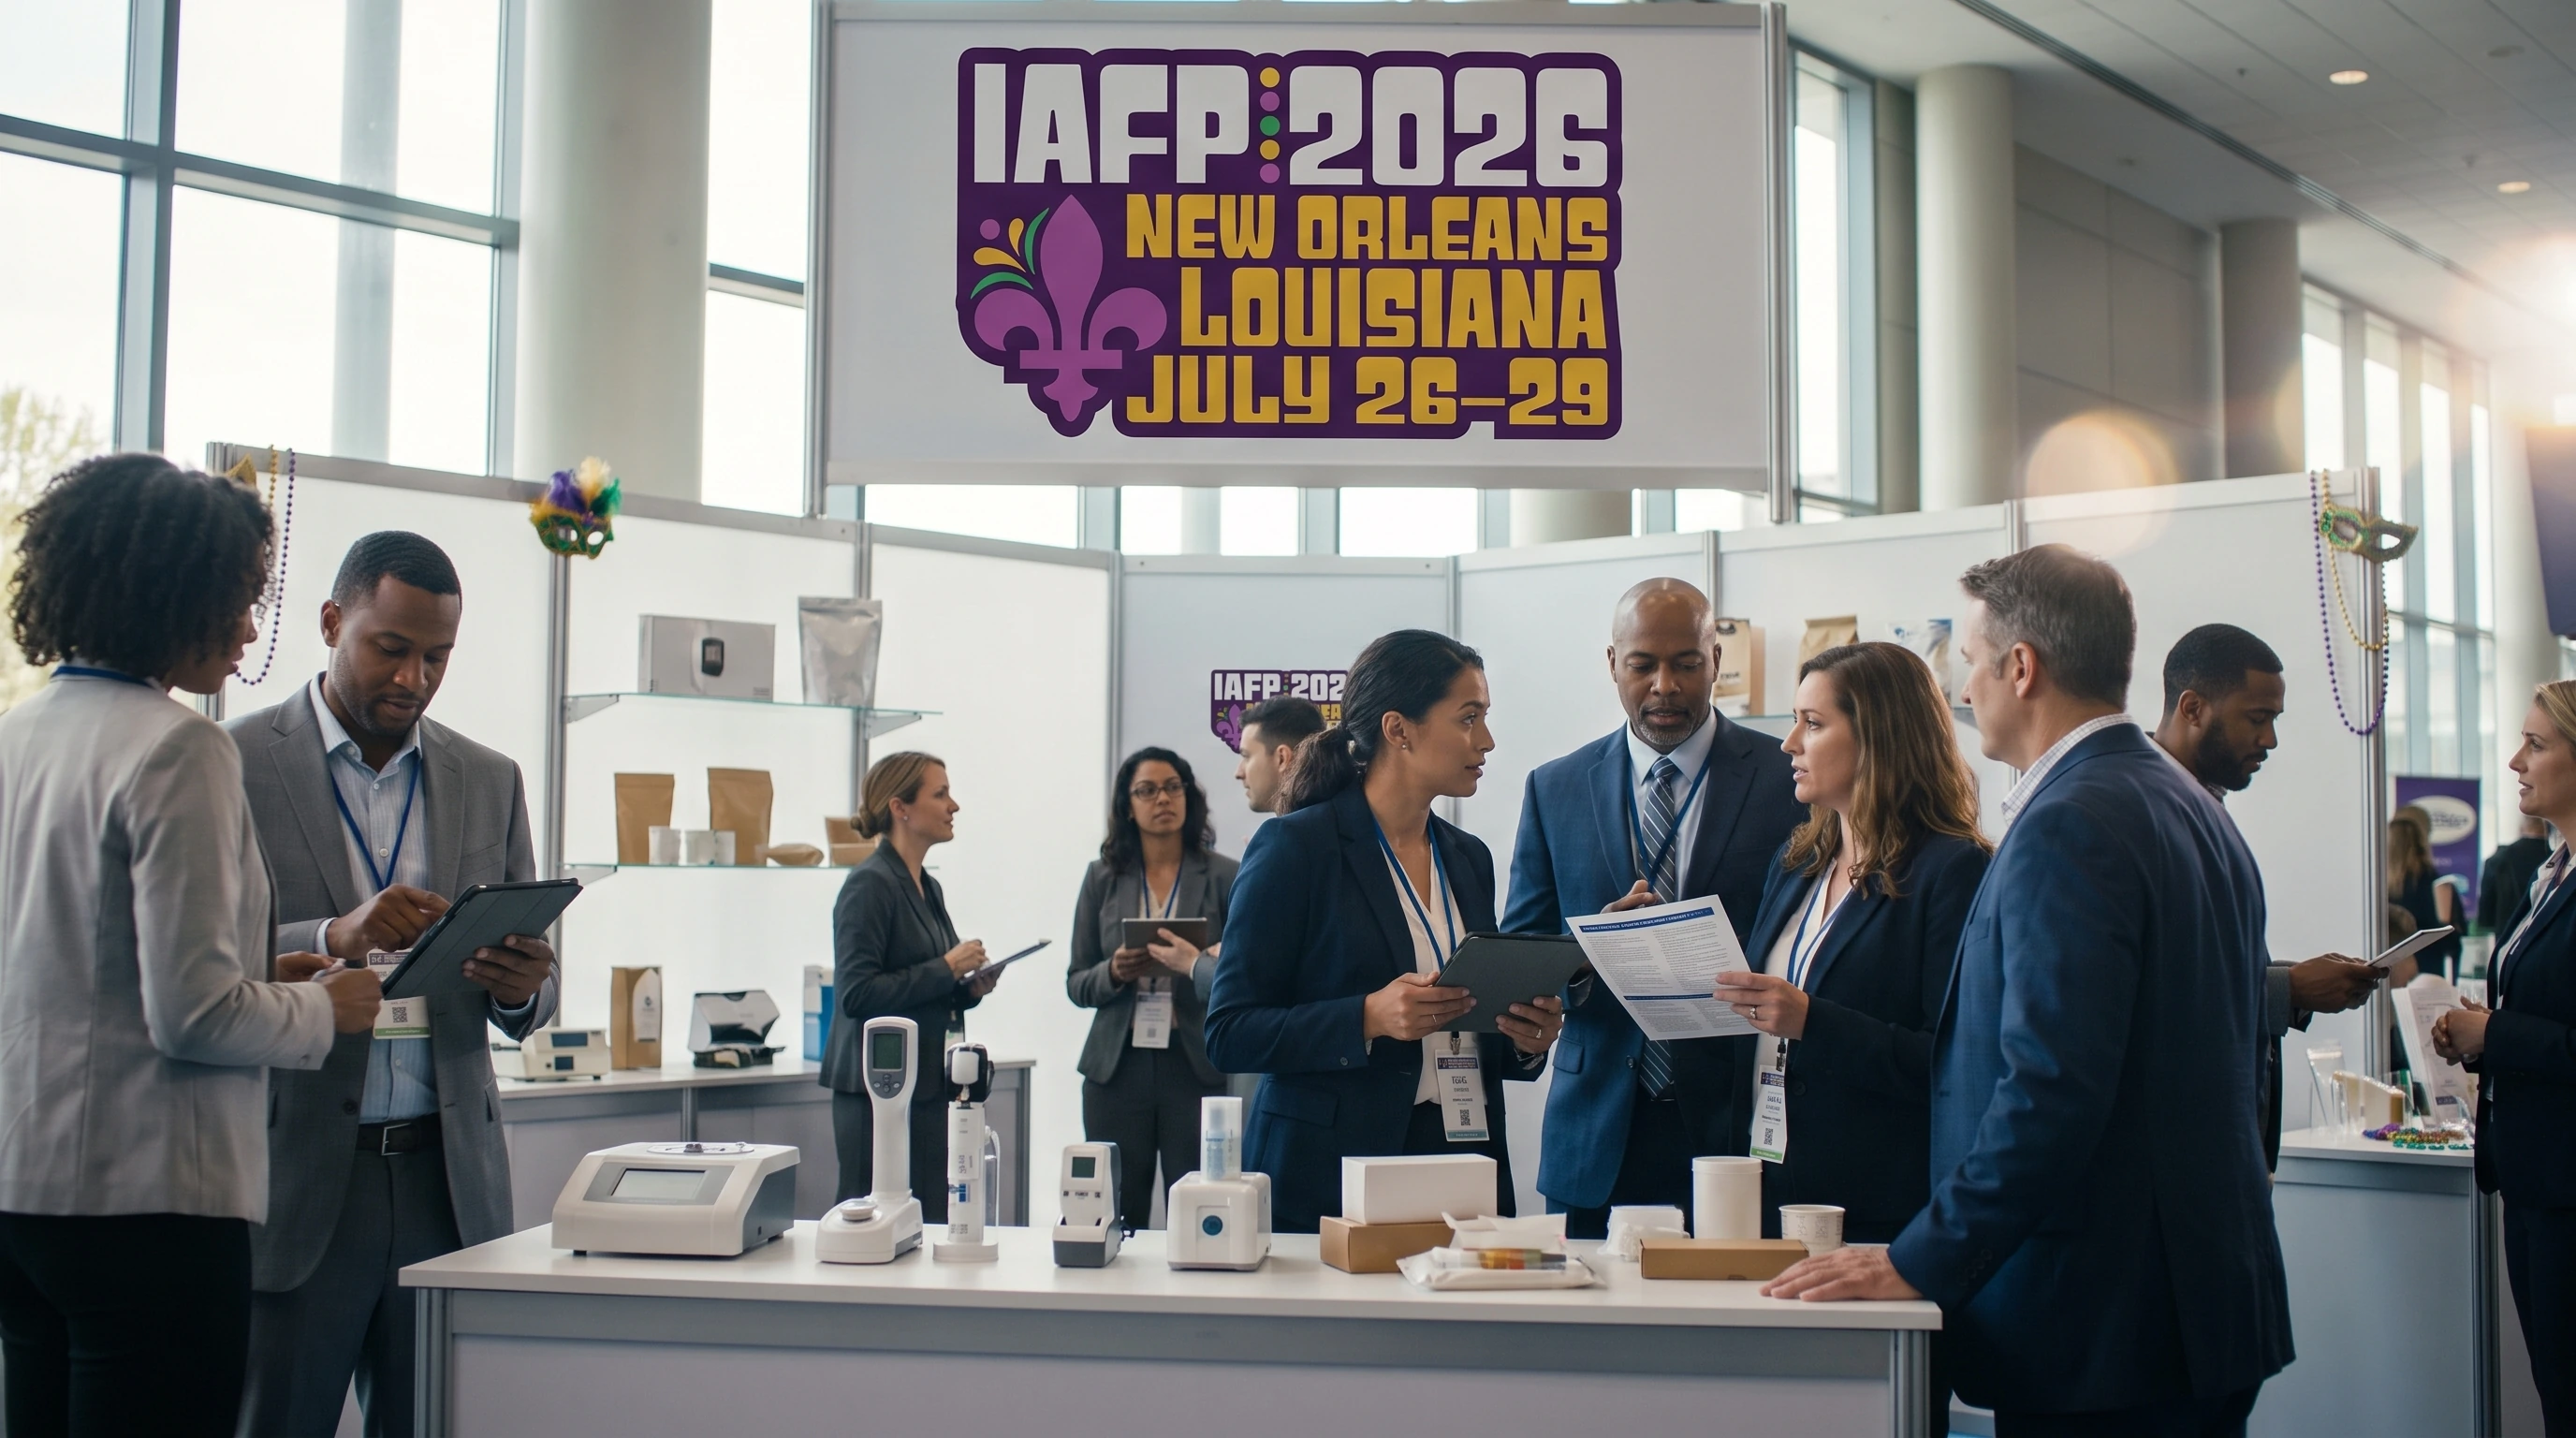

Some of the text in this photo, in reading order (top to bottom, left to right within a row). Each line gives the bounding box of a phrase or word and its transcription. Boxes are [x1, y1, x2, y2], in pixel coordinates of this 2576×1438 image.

[973, 63, 1609, 187] IAFP 2026
[1126, 193, 1609, 261] NEW ORLEANS
[1180, 266, 1608, 349] LOUISIANA
[1126, 355, 1330, 424] JULY
[1214, 672, 1347, 701] IAFP 202
